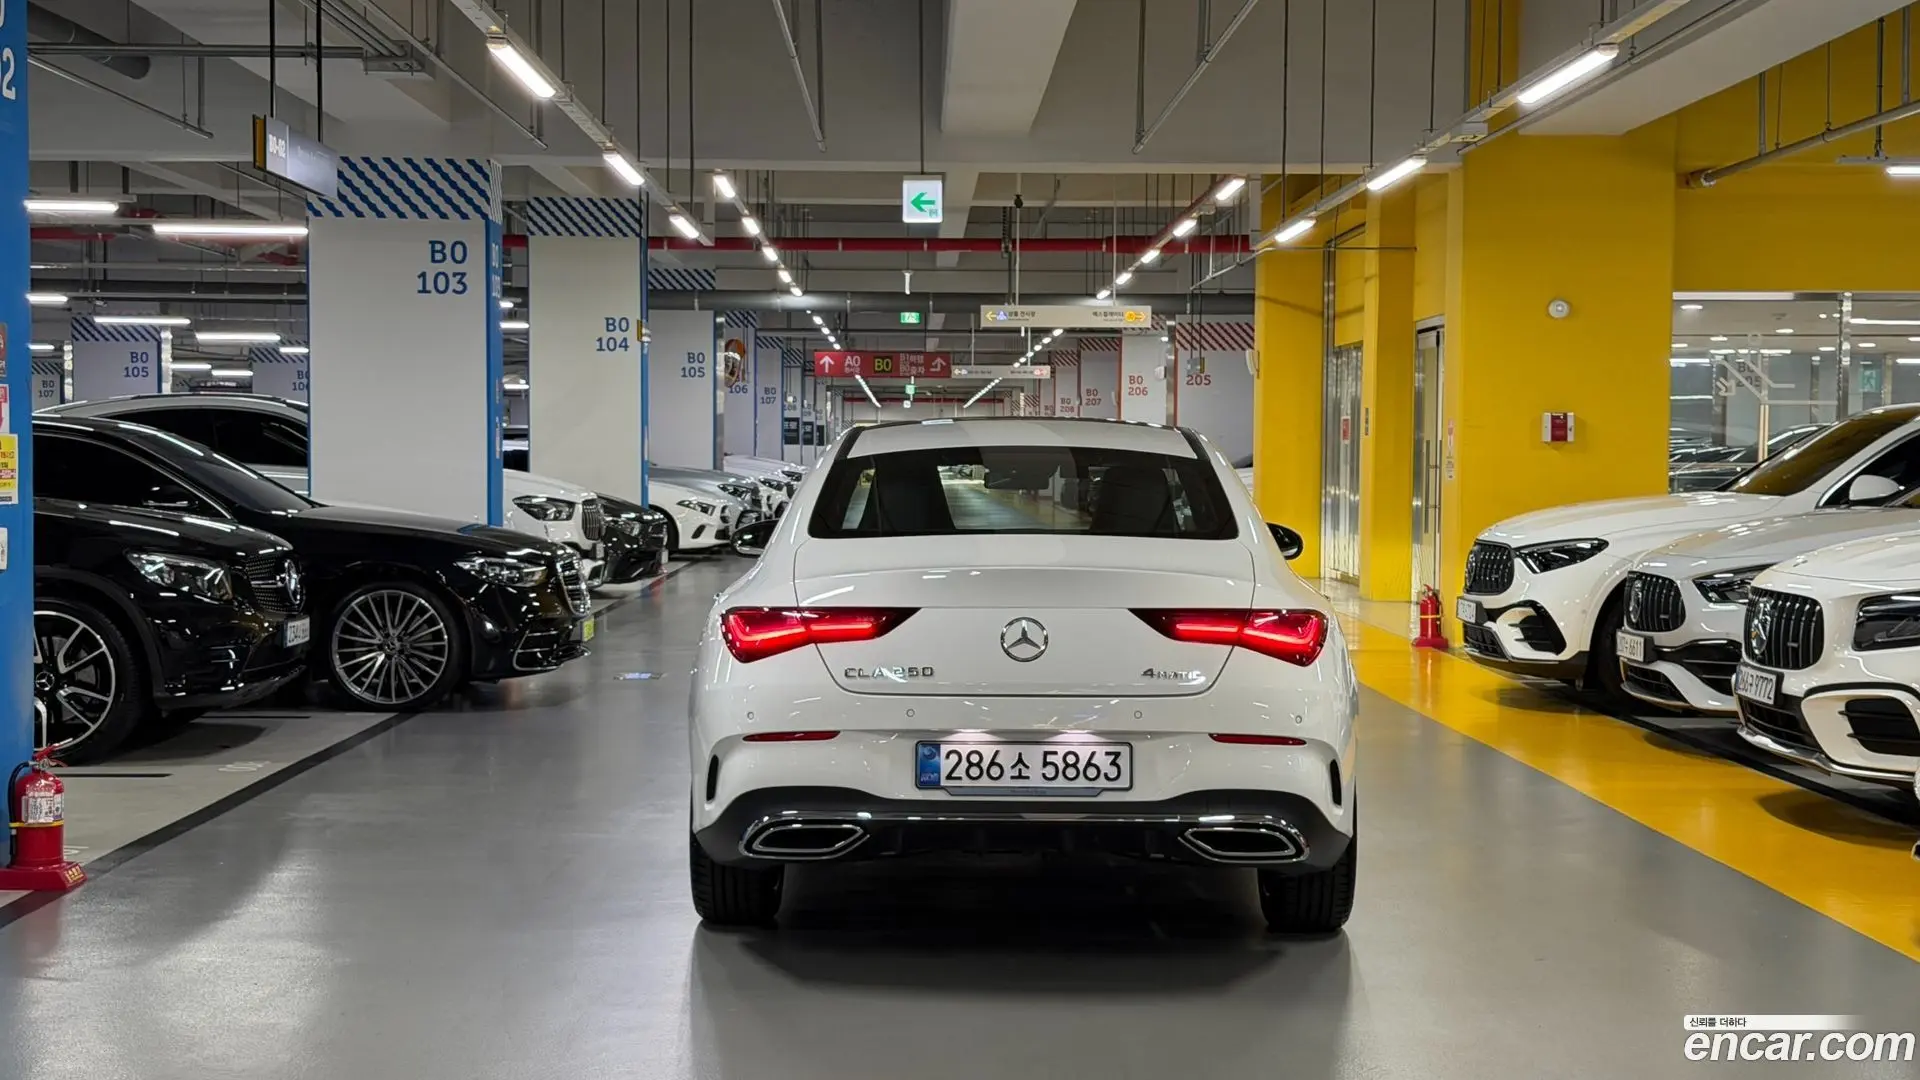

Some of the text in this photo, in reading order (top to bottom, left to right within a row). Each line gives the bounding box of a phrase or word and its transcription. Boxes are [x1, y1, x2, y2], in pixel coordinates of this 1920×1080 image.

[0, 47, 16, 100] 2
[428, 239, 468, 264] B0
[417, 271, 468, 294] 103
[604, 316, 630, 332] B0
[596, 337, 630, 351] 104
[130, 351, 149, 364] B0
[687, 352, 706, 364] B0
[874, 358, 892, 372] B0
[124, 366, 149, 378] 105
[680, 366, 706, 378] 105
[1128, 375, 1144, 385] B0
[1186, 374, 1212, 386] 205
[39, 390, 54, 398] 107
[728, 384, 749, 394] 106
[1128, 387, 1149, 396] 206
[761, 397, 777, 405] 107
[1085, 398, 1101, 407] 207
[844, 666, 934, 678] CLA 250
[945, 749, 1122, 782] 286소 5863
